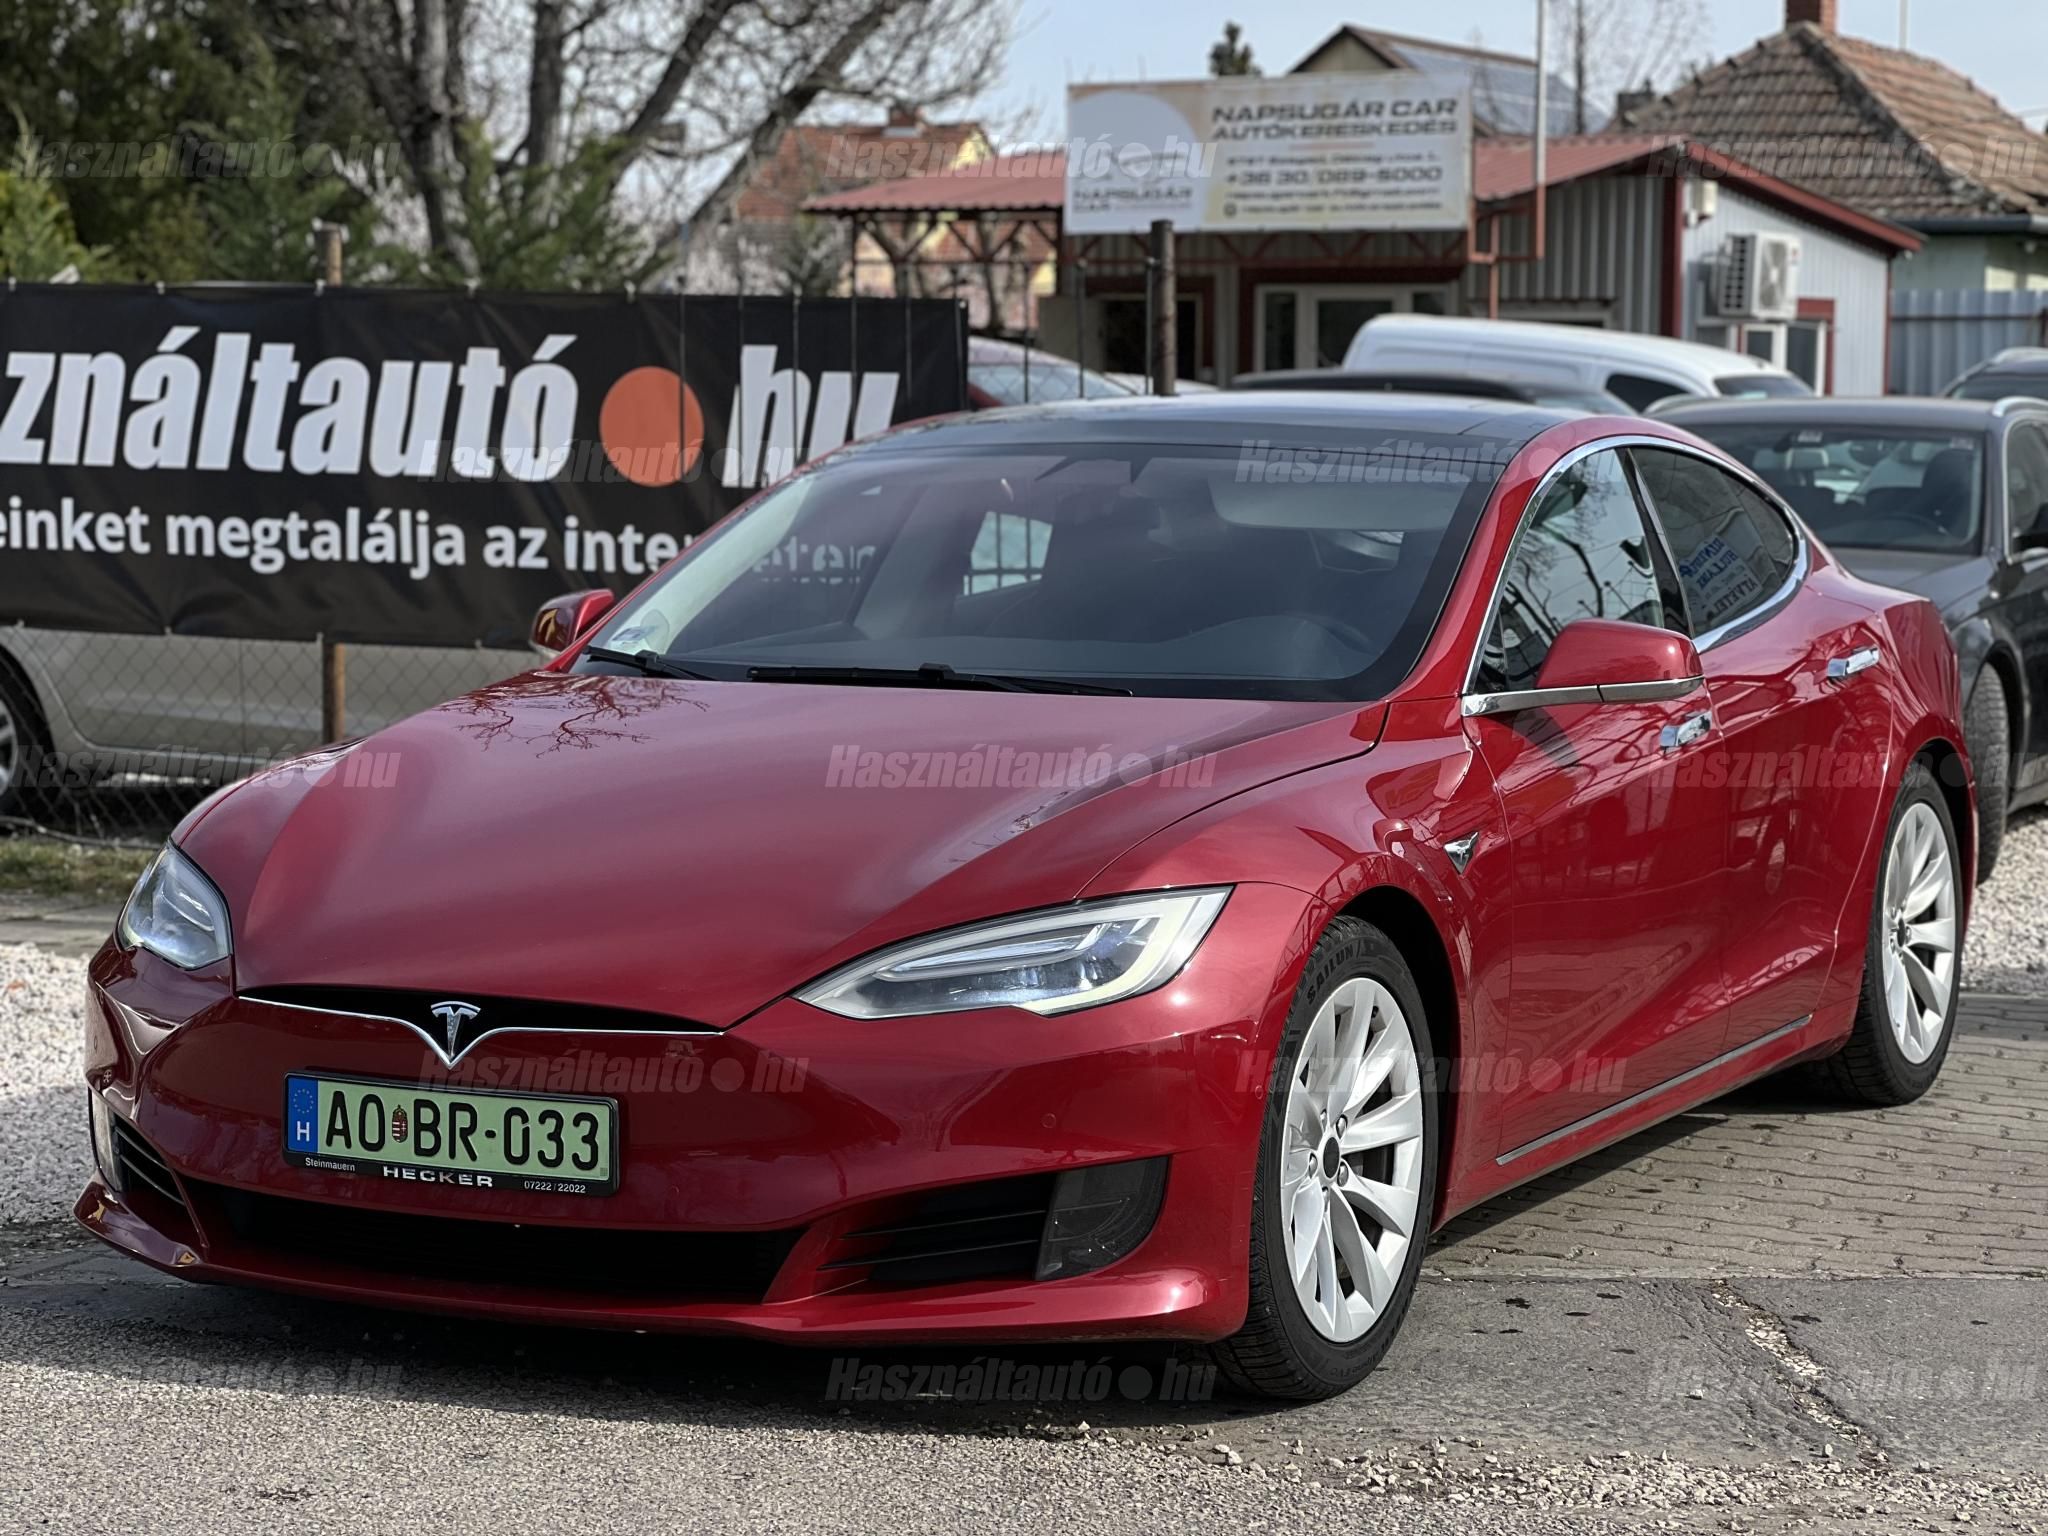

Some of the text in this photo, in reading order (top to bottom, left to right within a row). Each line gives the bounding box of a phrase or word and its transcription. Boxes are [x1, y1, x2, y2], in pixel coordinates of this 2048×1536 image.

[1212, 98, 1458, 123] NAPSUGÁR CAR
[0, 326, 578, 482] ználtautó
[166, 506, 466, 580] megtalálja
[482, 525, 549, 569] az
[1307, 946, 1355, 1005] SAILUN
[413, 1098, 600, 1171] BR-033
[304, 1157, 356, 1172] Steinmauern
[382, 1165, 494, 1188] HECKER
